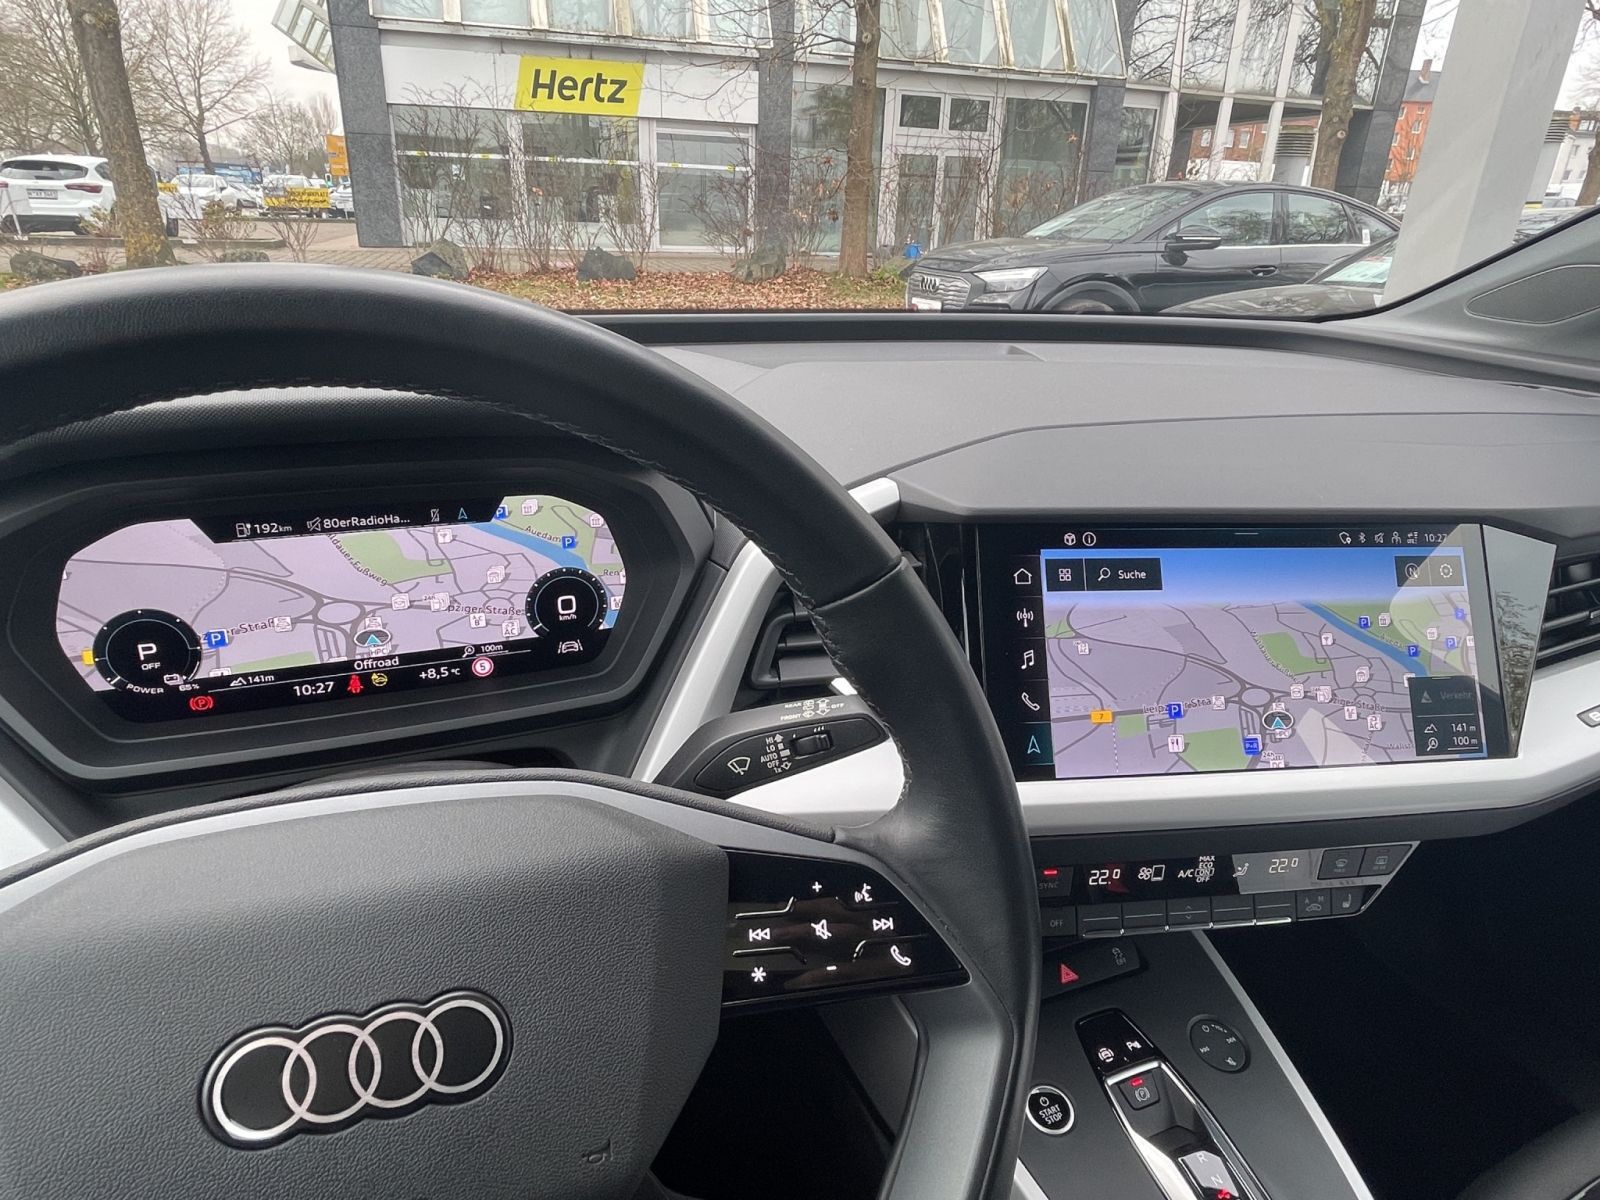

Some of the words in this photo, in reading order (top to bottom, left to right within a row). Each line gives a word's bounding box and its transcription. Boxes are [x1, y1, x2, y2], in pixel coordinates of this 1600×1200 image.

[531, 69, 628, 103] Hertz
[525, 525, 561, 542] Auedam
[1424, 533, 1448, 543] 10:27
[1118, 570, 1147, 580] Suche
[448, 605, 483, 613] pziger
[558, 595, 577, 614] 0
[137, 643, 157, 661] P
[481, 644, 503, 652] 100m
[141, 662, 161, 671] OFF
[354, 656, 399, 671] Offroad
[480, 662, 487, 671] 5
[248, 673, 275, 683] 141m
[419, 667, 449, 681] +8,5
[126, 683, 164, 694] POWER
[293, 681, 335, 697] 10:27
[1451, 722, 1467, 732] 141
[1453, 736, 1470, 746] 100
[766, 745, 776, 753] LO
[760, 752, 778, 763] AUTO
[767, 760, 780, 768] OFF
[1177, 869, 1194, 878] A/C
[1050, 919, 1064, 928] OFF
[1039, 1104, 1061, 1118] START
[1045, 1112, 1062, 1124] STOP
